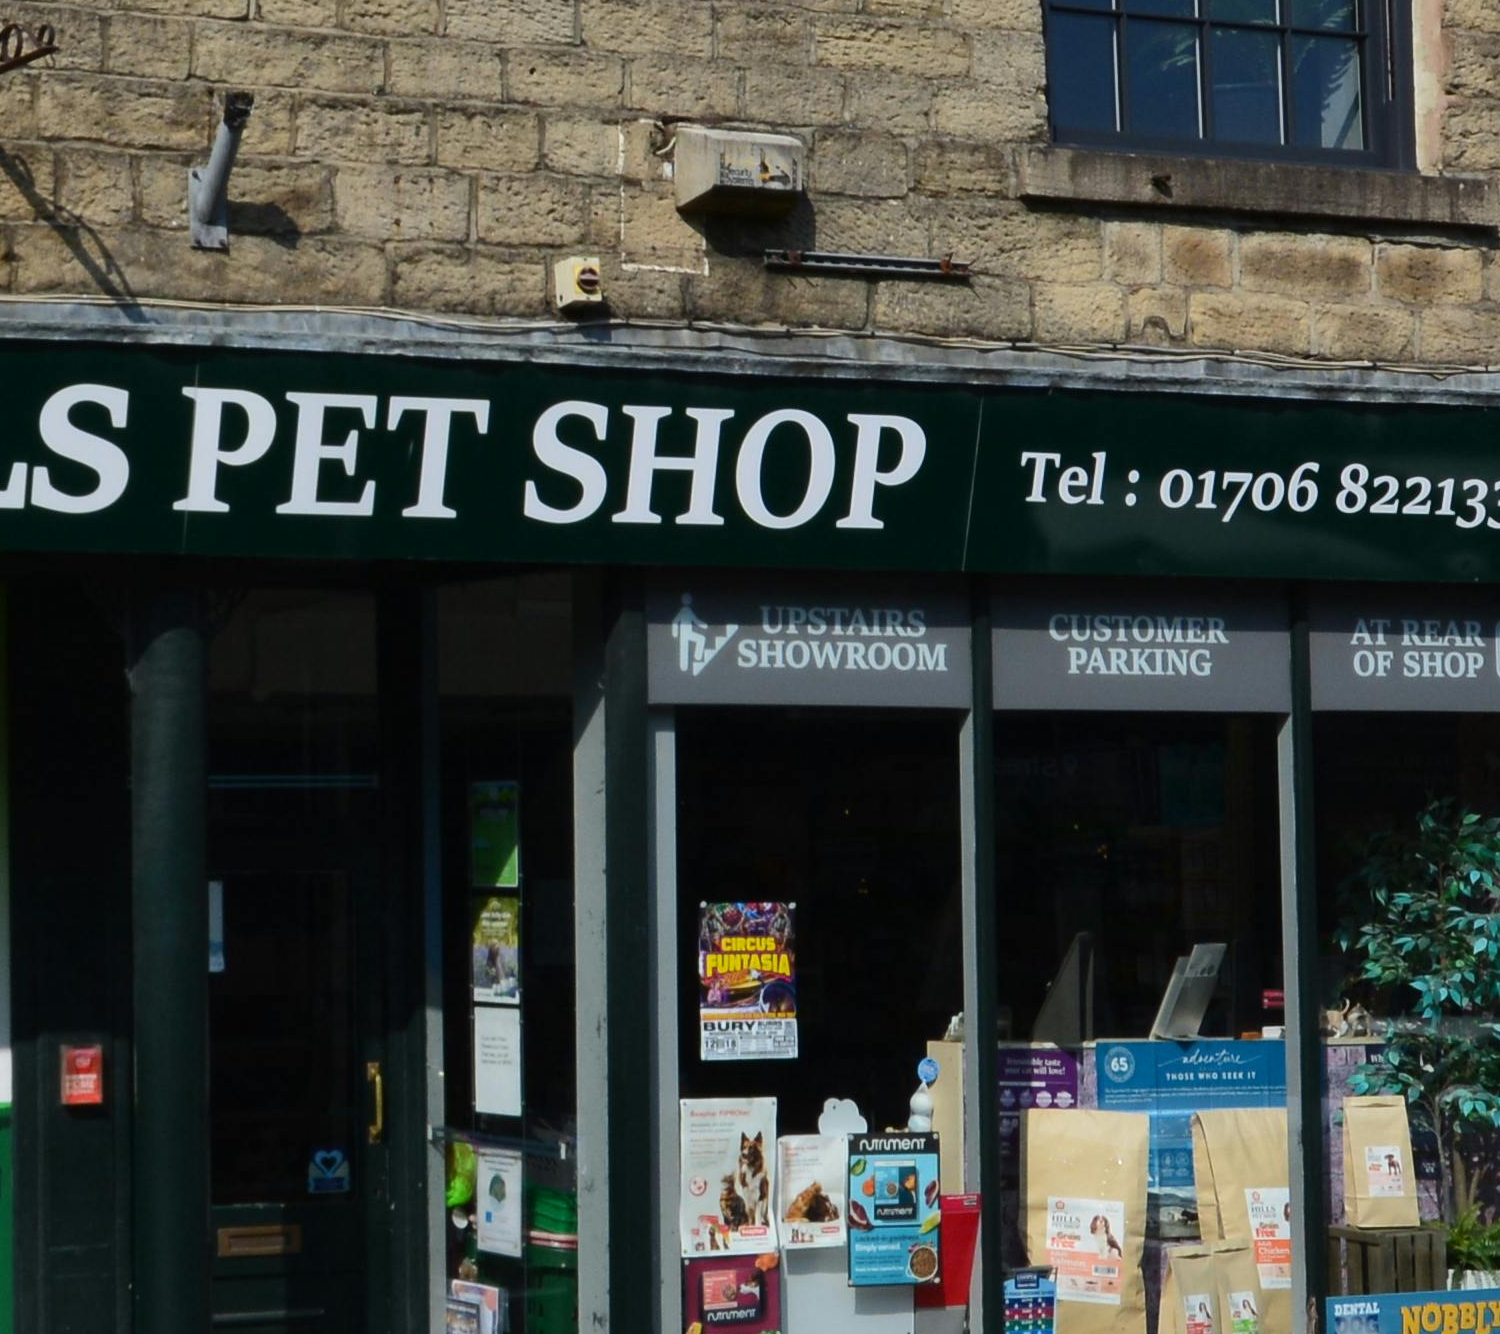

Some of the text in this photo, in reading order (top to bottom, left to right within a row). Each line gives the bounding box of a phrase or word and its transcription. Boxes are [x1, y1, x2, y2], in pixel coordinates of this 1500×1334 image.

[172, 386, 490, 518] PET
[524, 400, 927, 529] SHOP
[1021, 450, 1106, 505] Tel
[1159, 462, 1320, 522] 01706
[760, 605, 926, 637] UPSTAIRS
[1048, 613, 1229, 644] CUSTOMER
[1350, 619, 1486, 648] AT REAR
[737, 640, 948, 671] SHOWROOM
[1068, 647, 1212, 676] PARKING
[1353, 650, 1485, 679] OF SHOP
[721, 937, 776, 951] CIRCUS
[706, 953, 791, 977] FUNTASIA
[703, 1021, 756, 1032] BURY
[1111, 1056, 1129, 1072] 65
[1181, 1048, 1243, 1065] adventure
[1166, 1070, 1257, 1081] THOSE WHO SEEK IT
[1052, 1215, 1081, 1223] HILLS
[1258, 1247, 1290, 1256] Chicken
[1334, 1301, 1380, 1317] DENTAL
